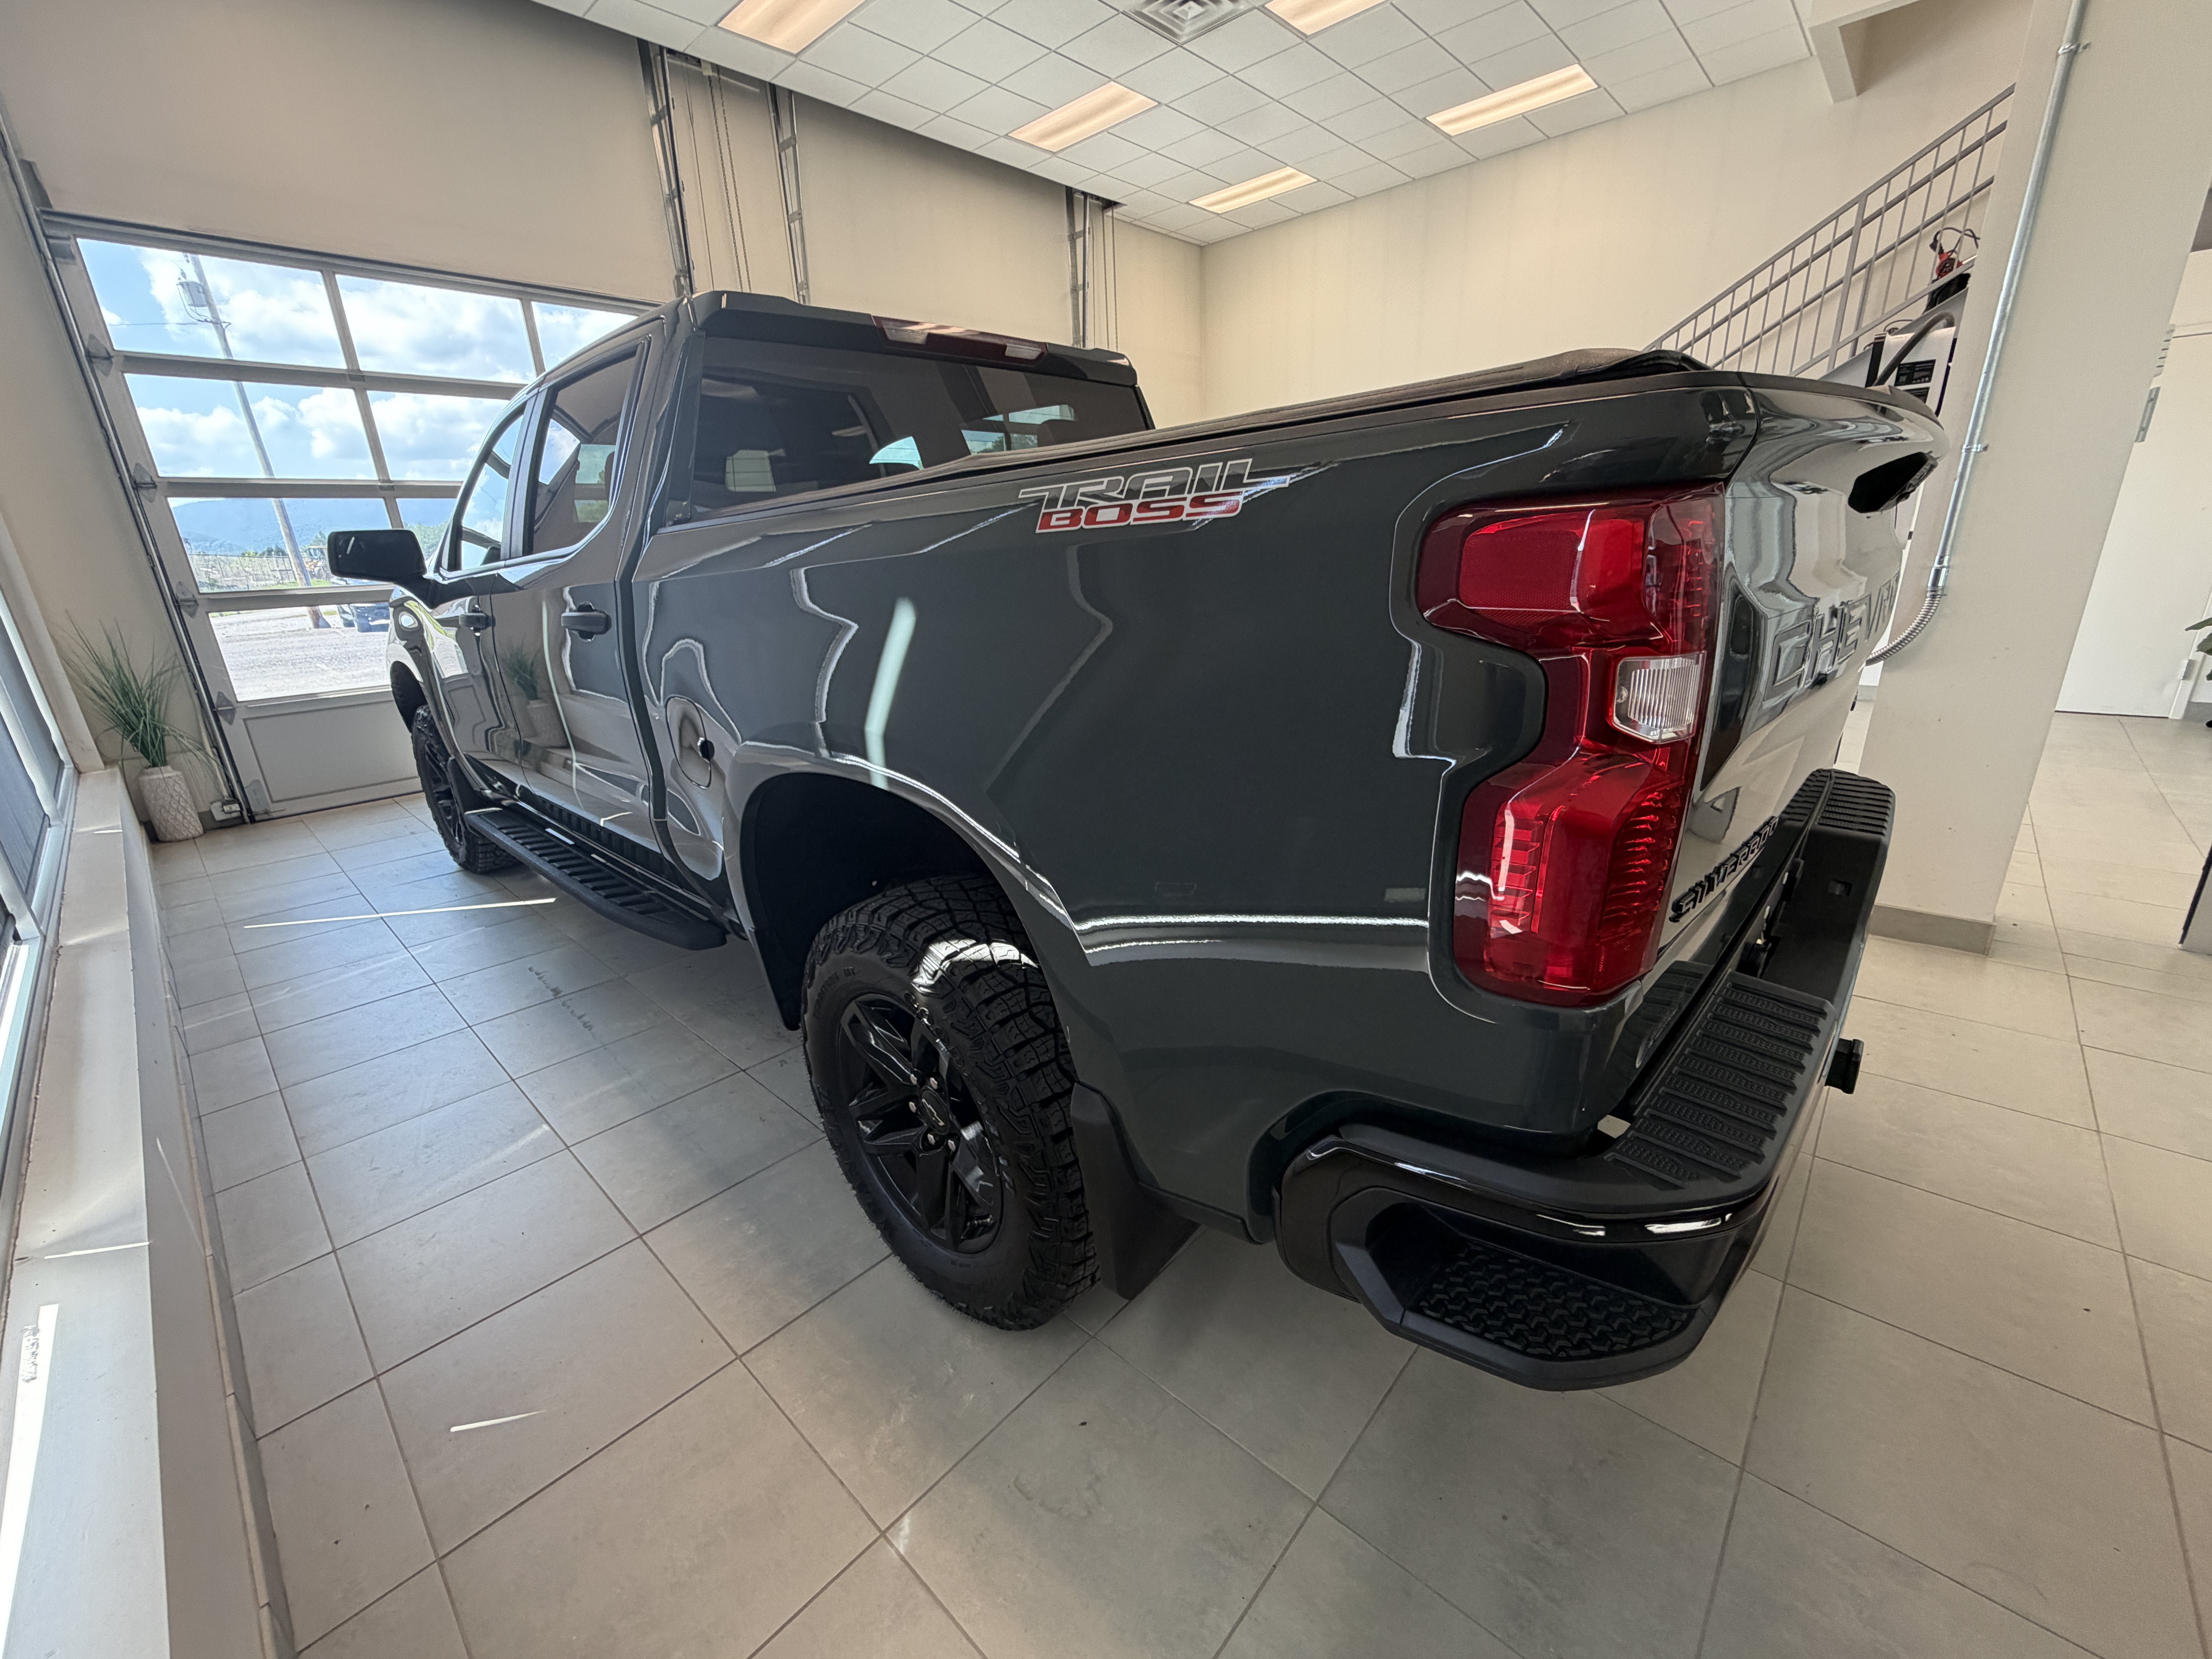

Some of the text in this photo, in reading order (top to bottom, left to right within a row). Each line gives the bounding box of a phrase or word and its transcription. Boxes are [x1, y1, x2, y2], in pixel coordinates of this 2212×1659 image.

[1018, 458, 1290, 510] TRAIL
[1035, 491, 1244, 533] BOSS
[1763, 574, 1900, 702] CHEVR
[1669, 816, 1779, 923] SILVERADO
